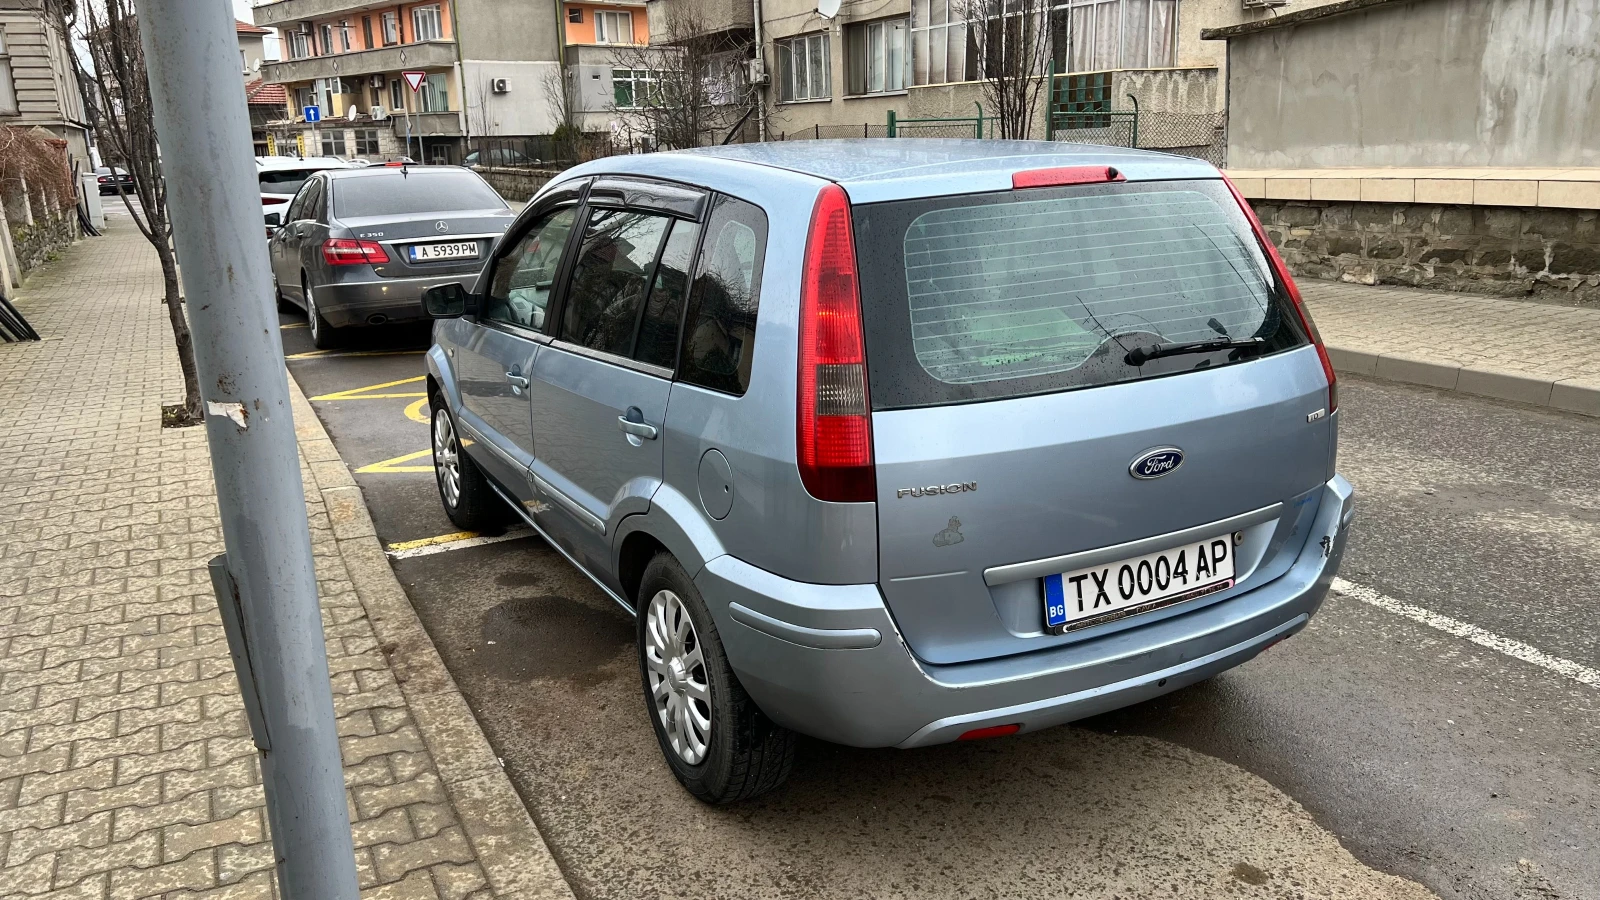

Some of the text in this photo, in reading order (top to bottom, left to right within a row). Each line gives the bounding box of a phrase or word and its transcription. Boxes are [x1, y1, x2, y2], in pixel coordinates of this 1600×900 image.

[422, 247, 429, 257] A
[433, 245, 460, 256] 5939
[461, 243, 477, 254] PM
[1144, 454, 1175, 475] Ford
[897, 480, 977, 499] FUSION
[1068, 539, 1228, 612] TX 0004 AP
[1049, 604, 1064, 618] BG
